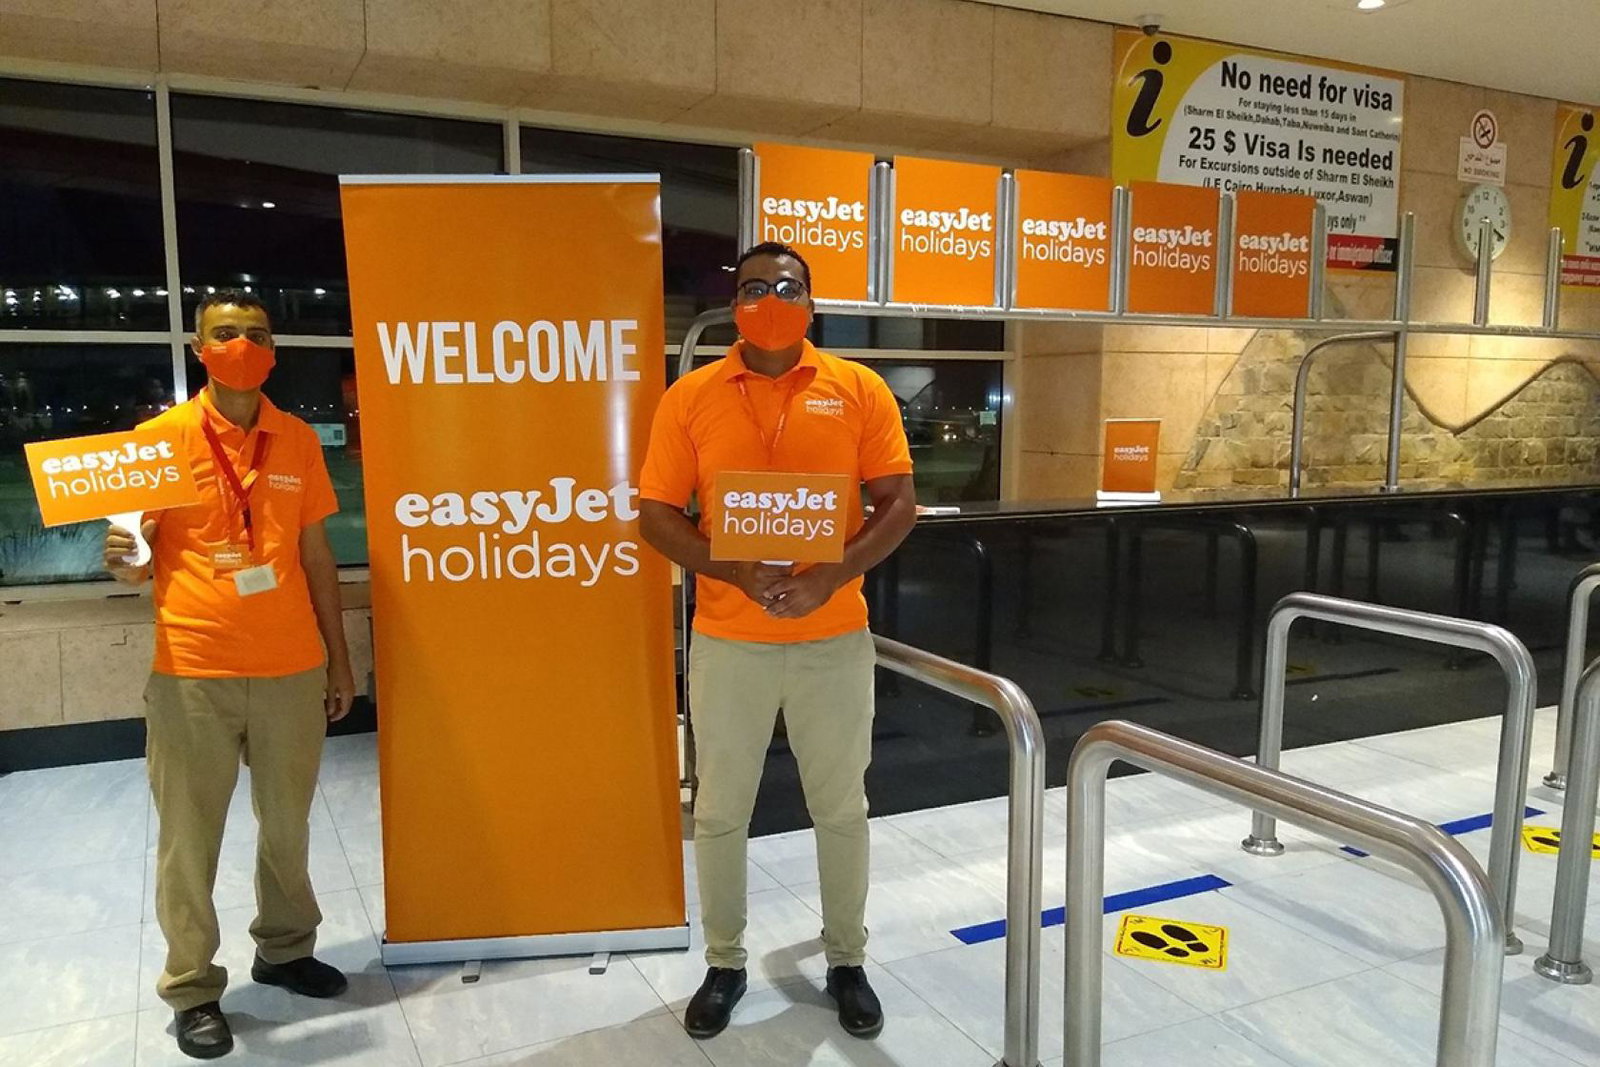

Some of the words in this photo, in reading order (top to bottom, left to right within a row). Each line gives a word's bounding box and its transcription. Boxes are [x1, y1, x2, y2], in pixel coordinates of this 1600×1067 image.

[1221, 61, 1251, 90] No
[1259, 73, 1312, 99] need
[1318, 76, 1347, 104] for
[1353, 83, 1392, 111] visa
[1184, 105, 1213, 117] (Sharm
[1216, 109, 1224, 119] El
[1336, 126, 1350, 135] and
[1238, 97, 1251, 107] For
[1253, 100, 1282, 114] staying
[1284, 103, 1299, 114] less
[1301, 106, 1317, 117] than
[1321, 109, 1329, 118] 15
[1331, 111, 1347, 122] days
[1349, 113, 1357, 122] in
[1188, 126, 1215, 151] 25
[1223, 129, 1236, 156] $
[1244, 132, 1290, 159] Visa
[1298, 139, 1315, 162] Is
[1322, 147, 1393, 171] needed
[1179, 155, 1197, 168] For
[1200, 157, 1260, 175] Excursions
[1262, 165, 1300, 179] outside
[1303, 168, 1314, 180] of
[1316, 169, 1348, 183] Sharm
[1351, 173, 1360, 185] El
[1363, 174, 1394, 188] Sheikh
[762, 196, 864, 223] easyJet
[900, 208, 992, 232] easyJet
[763, 217, 864, 252] holidays
[901, 228, 991, 261] holidays
[1022, 217, 1106, 241] easyJet
[1133, 226, 1212, 249] easyJet
[1239, 232, 1309, 254] easyJet
[1022, 237, 1105, 268] holidays
[1133, 246, 1211, 273] holidays
[1239, 251, 1307, 278] holidays
[376, 320, 640, 384] WELCOME
[41, 440, 174, 475] easyJet
[48, 465, 180, 499] holidays
[395, 477, 640, 534] easyJet
[723, 488, 837, 513] easyJet
[724, 510, 835, 541] holidays
[402, 530, 640, 587] holidays
